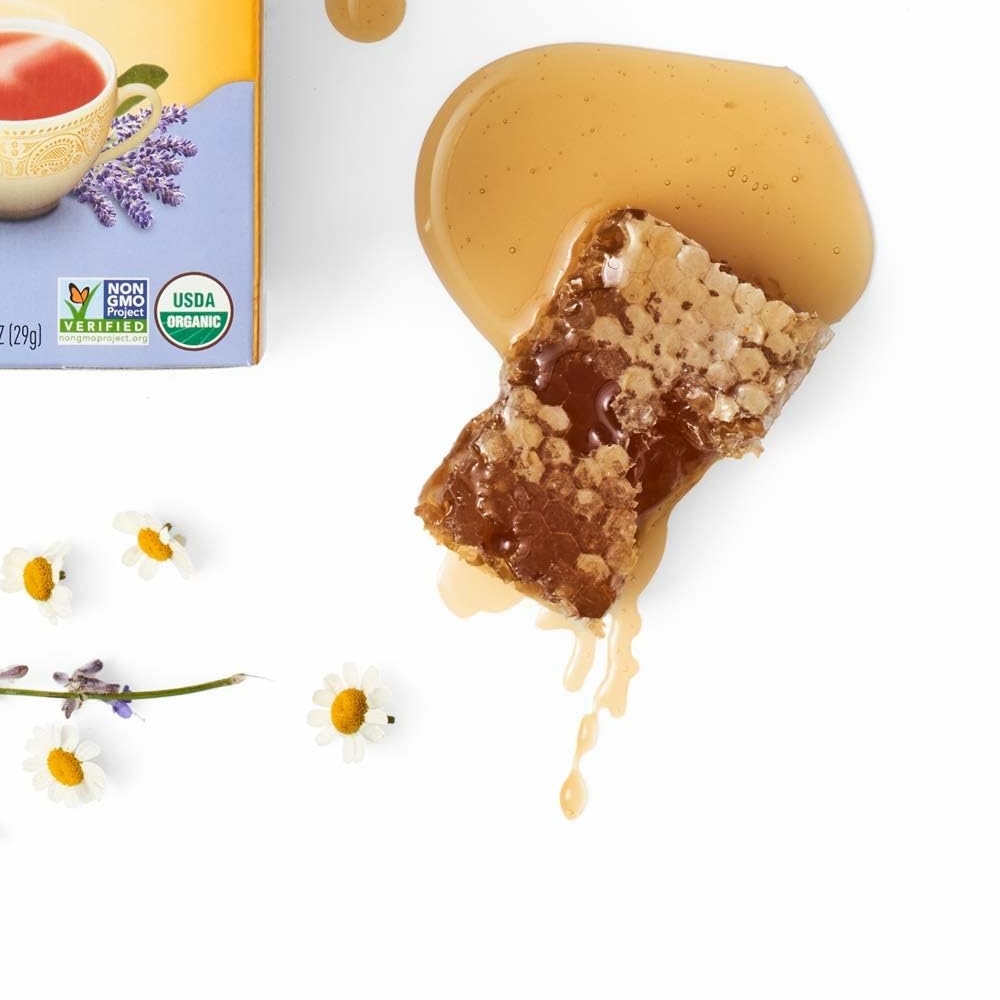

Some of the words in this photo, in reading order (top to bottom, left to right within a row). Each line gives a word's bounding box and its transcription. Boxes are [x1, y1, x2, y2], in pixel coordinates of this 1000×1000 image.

[108, 282, 144, 295] NON
[107, 295, 145, 308] GMO
[173, 292, 216, 308] USDA
[107, 306, 145, 319] Project
[64, 320, 144, 332] VERIFIED
[166, 315, 221, 329] ORGANIC
[9, 322, 42, 350] (29g)
[59, 334, 148, 344] nongmoproject.org
